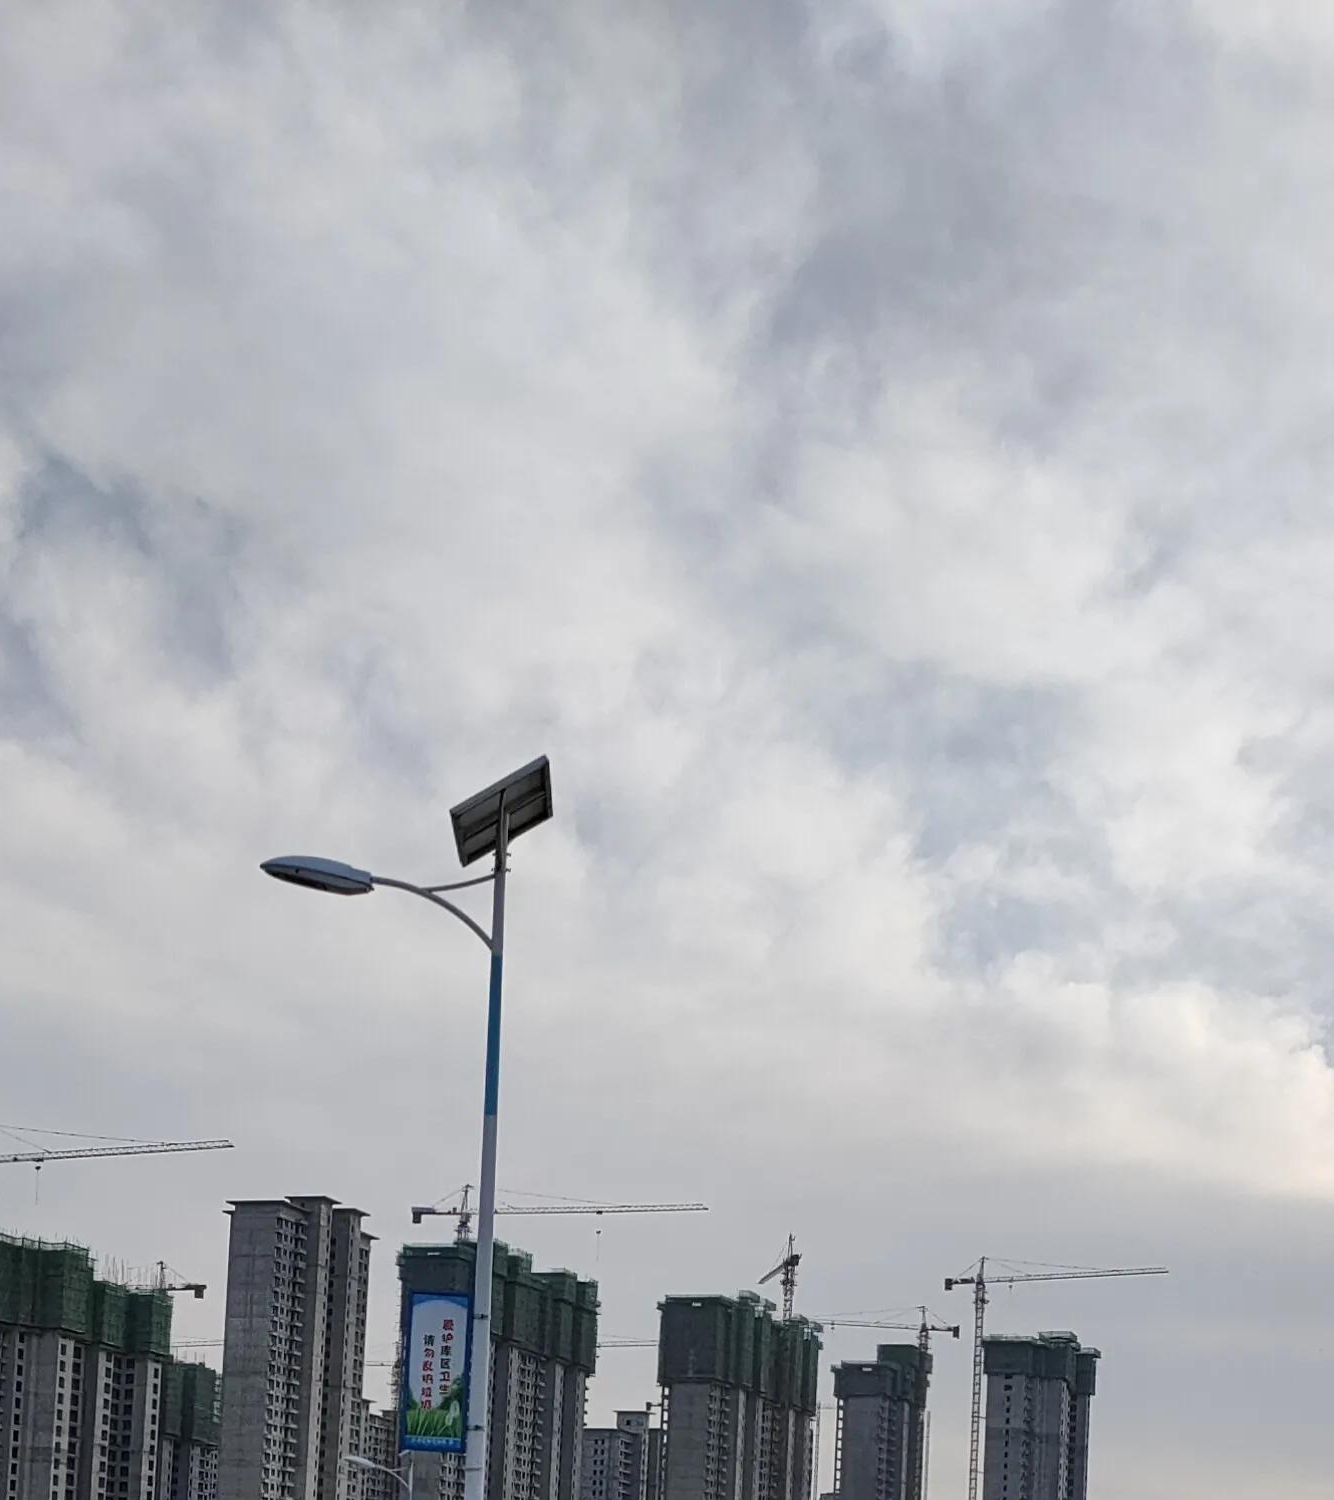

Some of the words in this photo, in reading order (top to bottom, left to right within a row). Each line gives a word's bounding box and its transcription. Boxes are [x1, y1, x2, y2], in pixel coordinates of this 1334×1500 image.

[420, 1334, 435, 1409] 请勿乱扔垃圾
